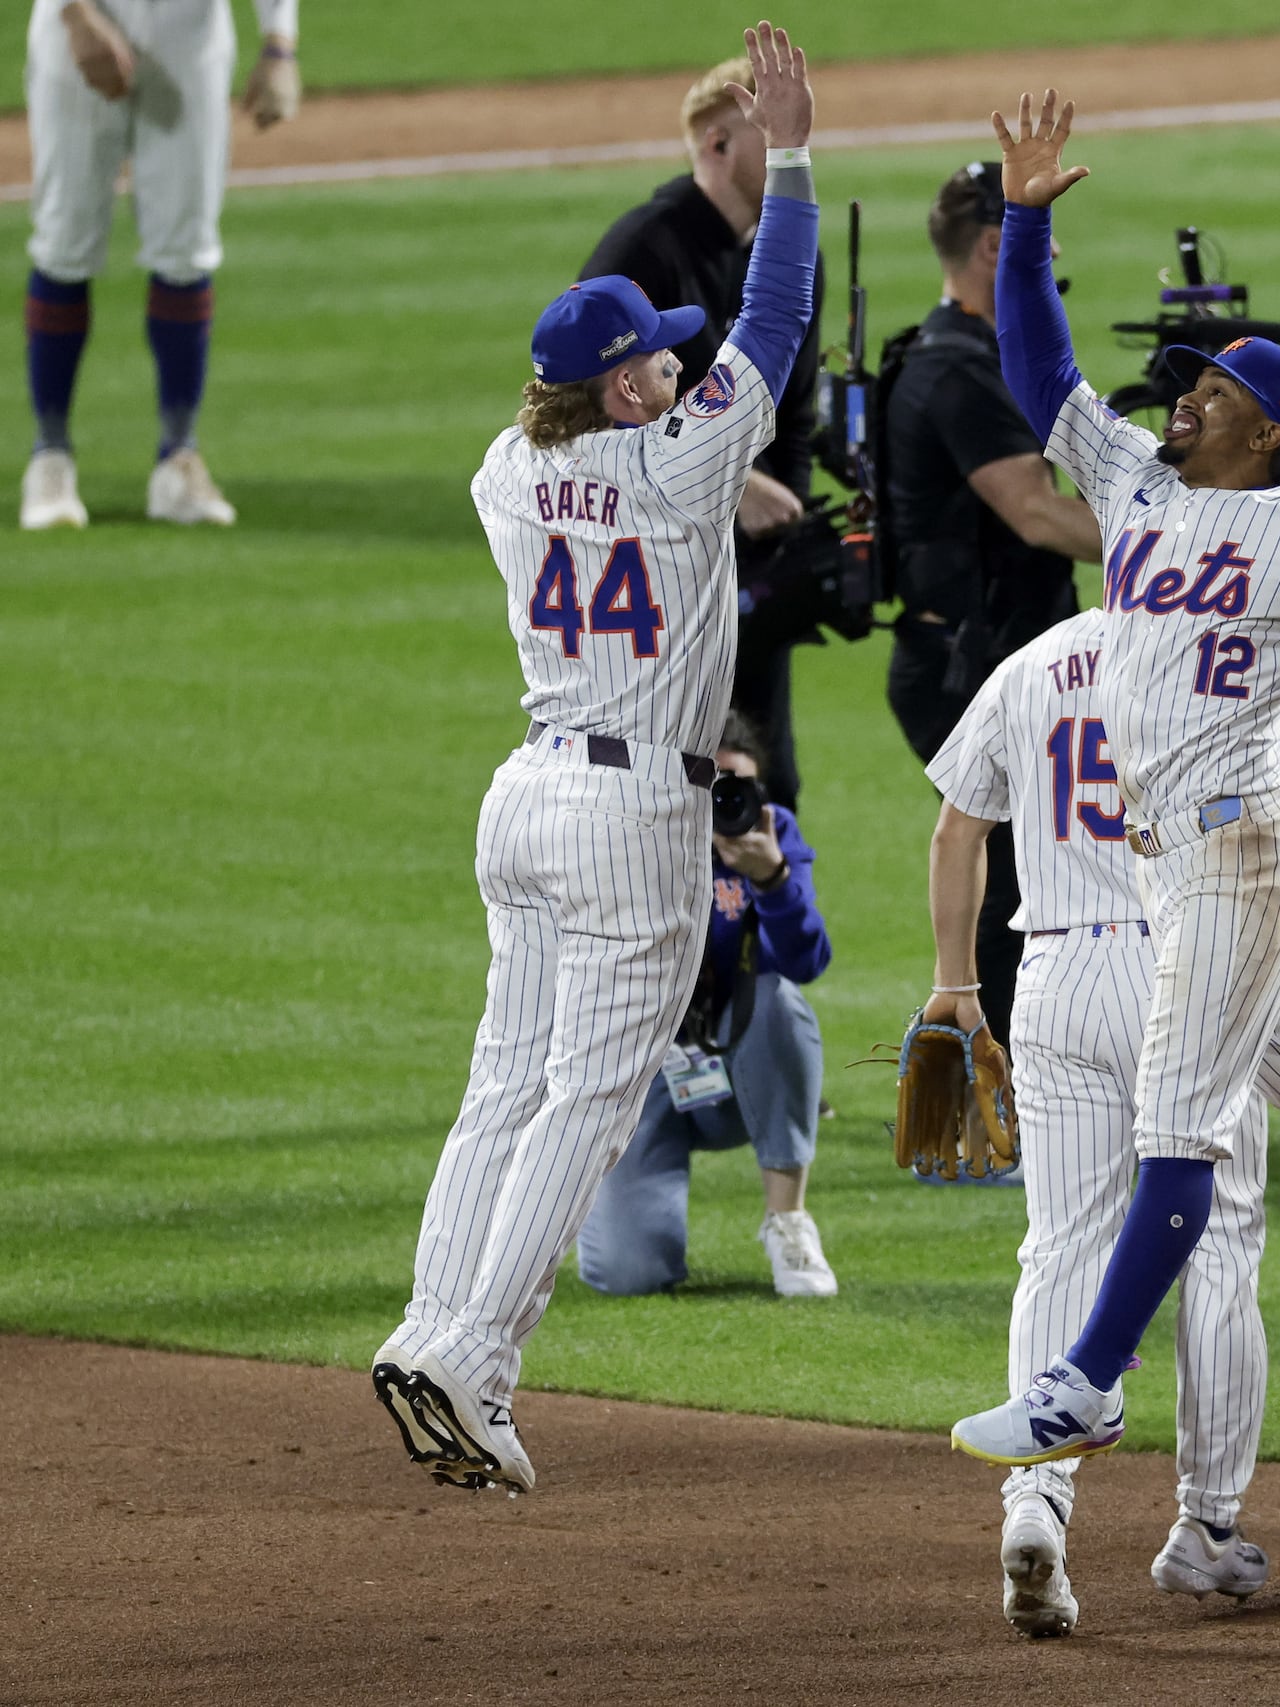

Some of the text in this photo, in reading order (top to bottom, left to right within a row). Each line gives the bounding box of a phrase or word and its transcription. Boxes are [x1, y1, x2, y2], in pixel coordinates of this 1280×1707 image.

[529, 535, 665, 659] 44
[1104, 528, 1256, 618] Mets
[1047, 649, 1102, 695] TAY
[1193, 629, 1257, 701] 12
[1047, 717, 1126, 842] 15
